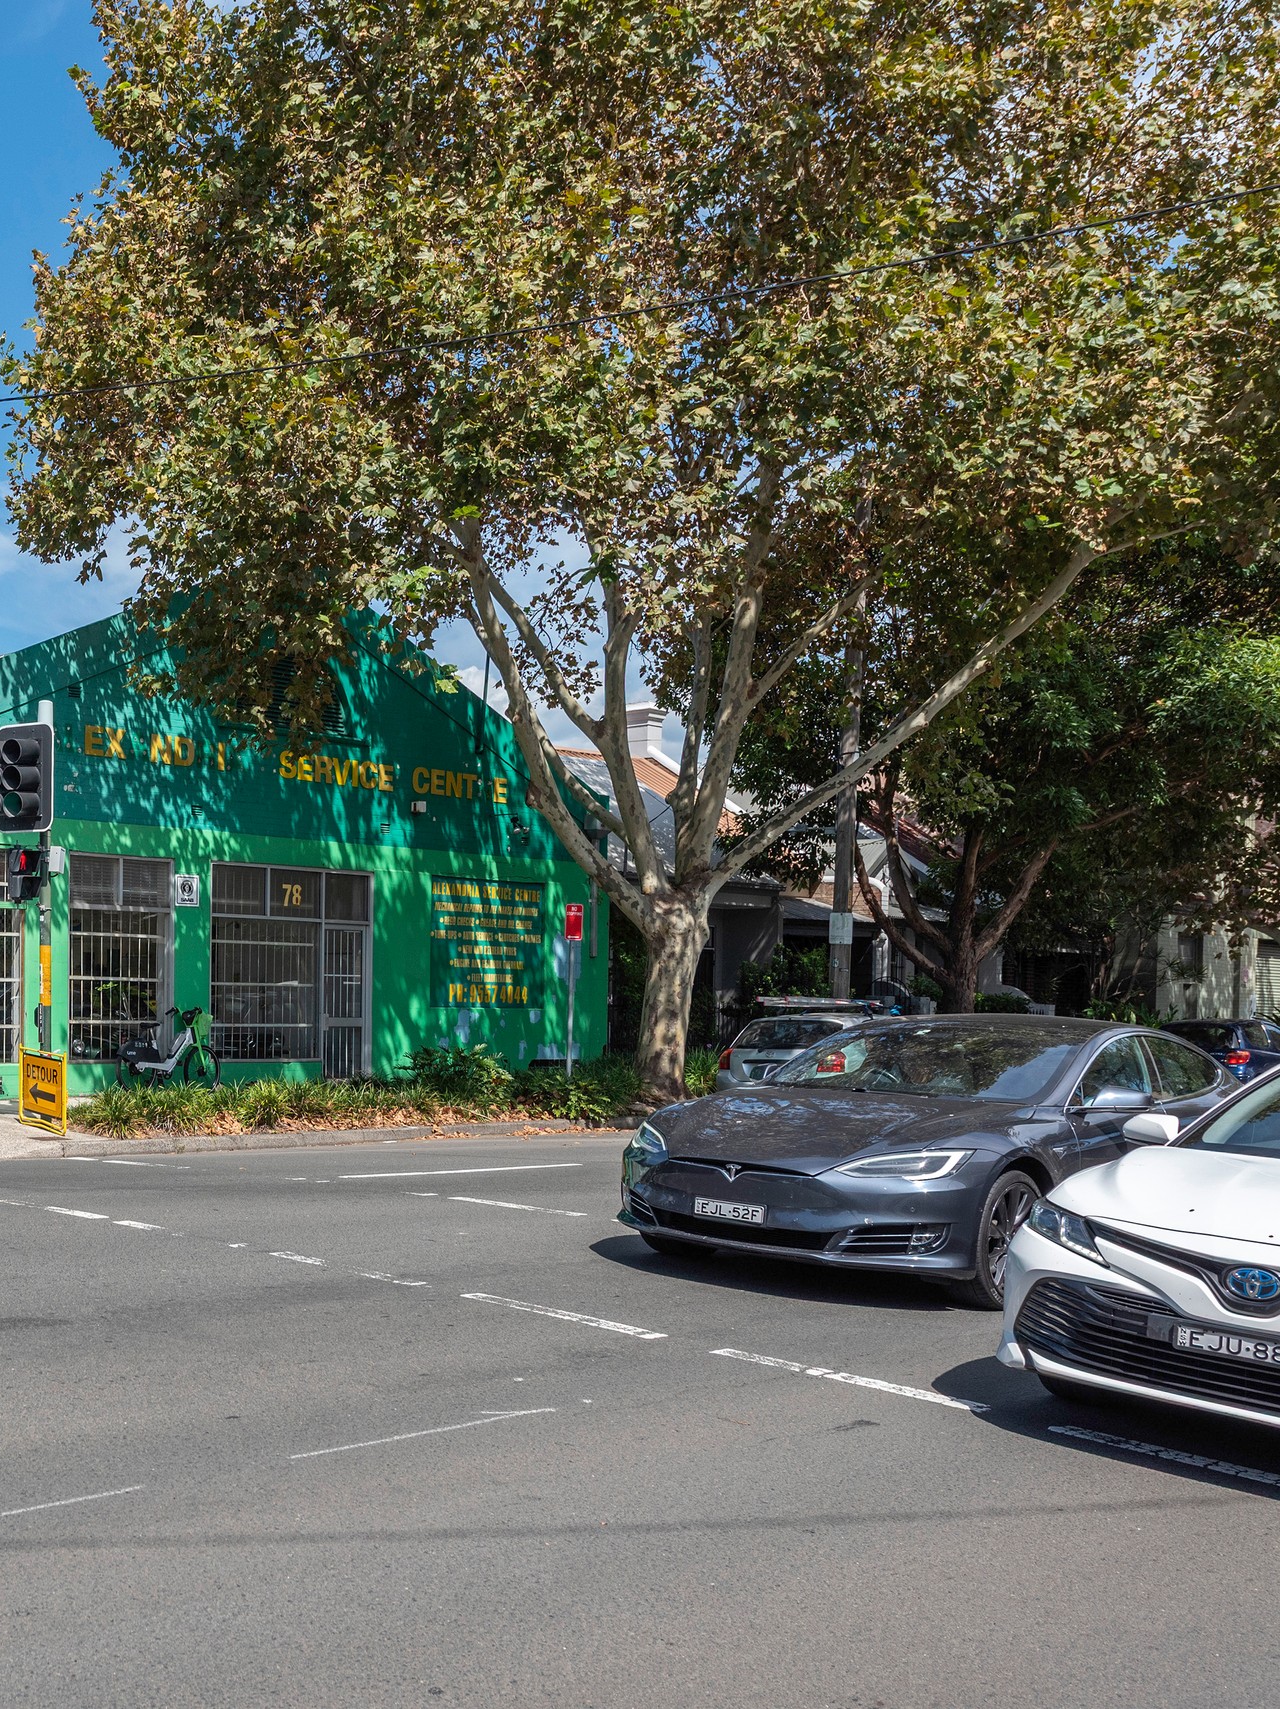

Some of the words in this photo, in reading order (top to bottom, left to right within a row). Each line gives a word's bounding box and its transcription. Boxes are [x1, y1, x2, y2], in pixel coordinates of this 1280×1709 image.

[279, 750, 394, 792] SERVICE
[282, 884, 302, 907] 78
[432, 882, 480, 898] ALEXANDRIA
[483, 885, 512, 900] SERVICE
[515, 888, 540, 902] CENTRE
[449, 984, 467, 1003] PH:
[470, 984, 498, 1003] 9557
[500, 985, 528, 1004] 4044
[26, 1063, 58, 1084] DETOUR
